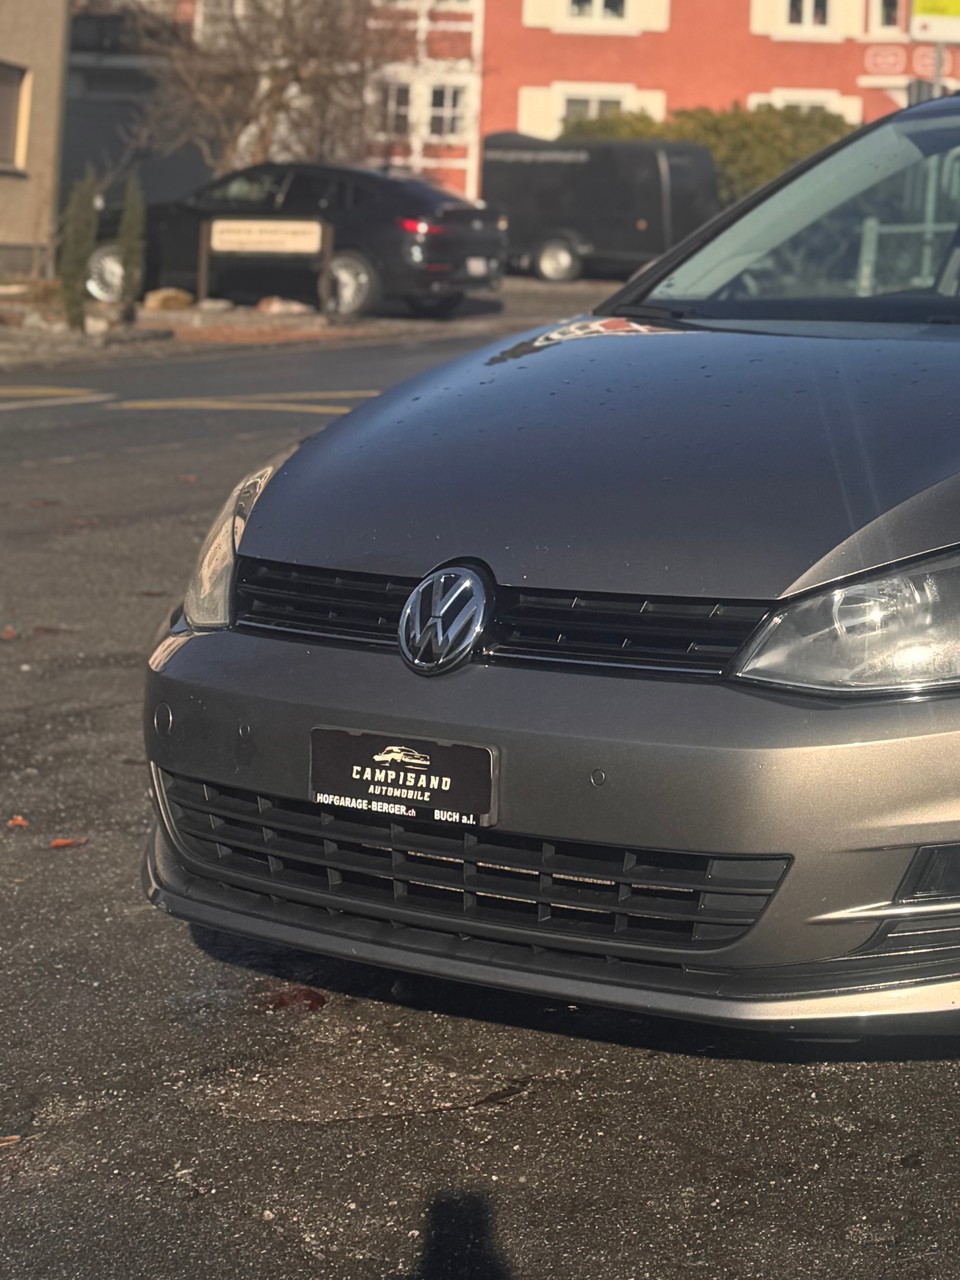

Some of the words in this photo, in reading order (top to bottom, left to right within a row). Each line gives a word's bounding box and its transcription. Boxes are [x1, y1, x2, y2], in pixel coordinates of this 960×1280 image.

[368, 785, 431, 801] AUTOMOBILE
[316, 792, 416, 817] HOFGARAGE-BERGER.ch
[434, 809, 460, 823] BUCH
